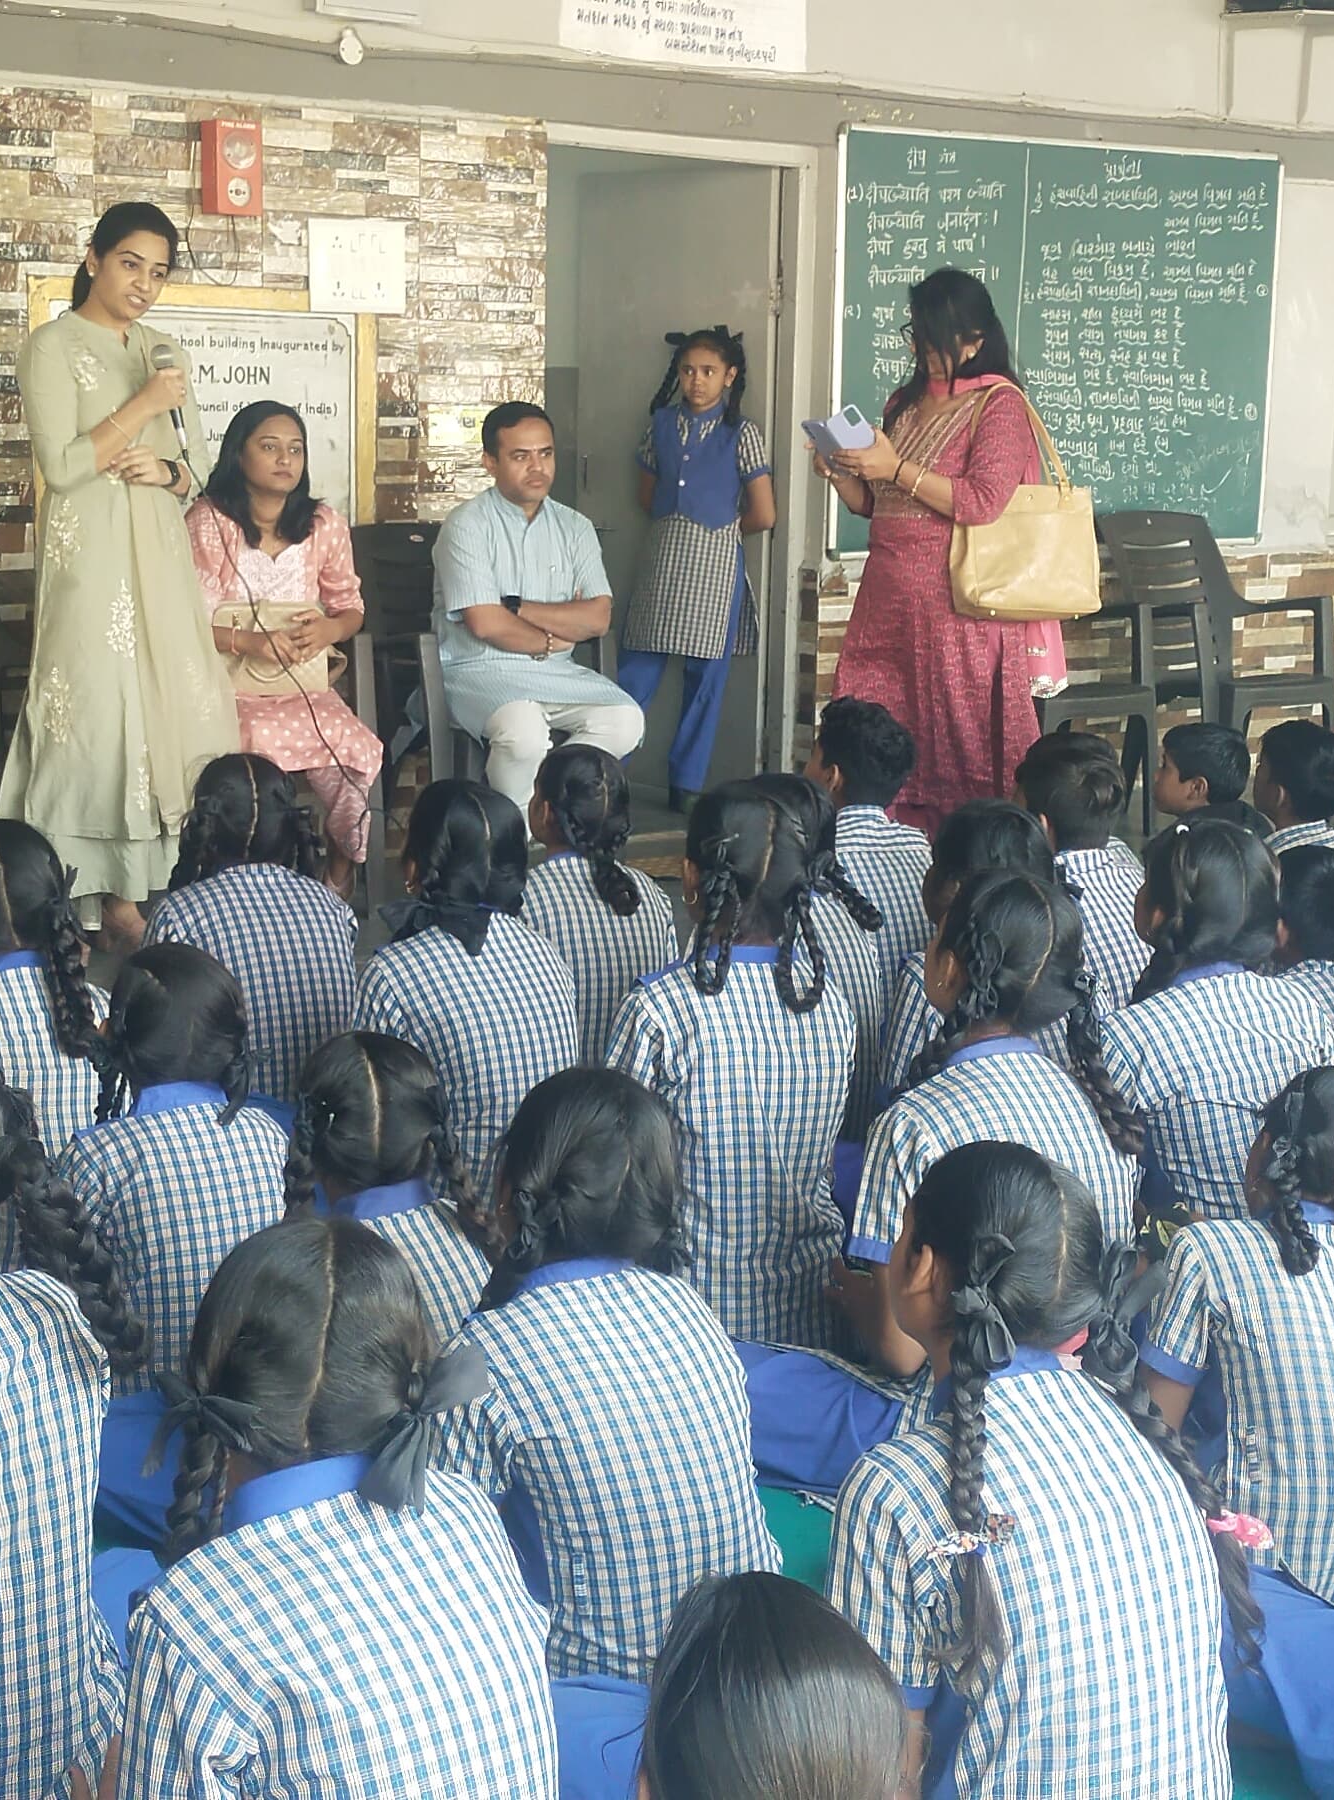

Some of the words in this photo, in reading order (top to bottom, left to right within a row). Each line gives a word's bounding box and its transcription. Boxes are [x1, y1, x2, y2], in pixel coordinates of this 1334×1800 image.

[176, 335, 204, 348] hool
[209, 335, 255, 352] building
[260, 336, 328, 354] Inaugurated
[332, 339, 345, 354] by
